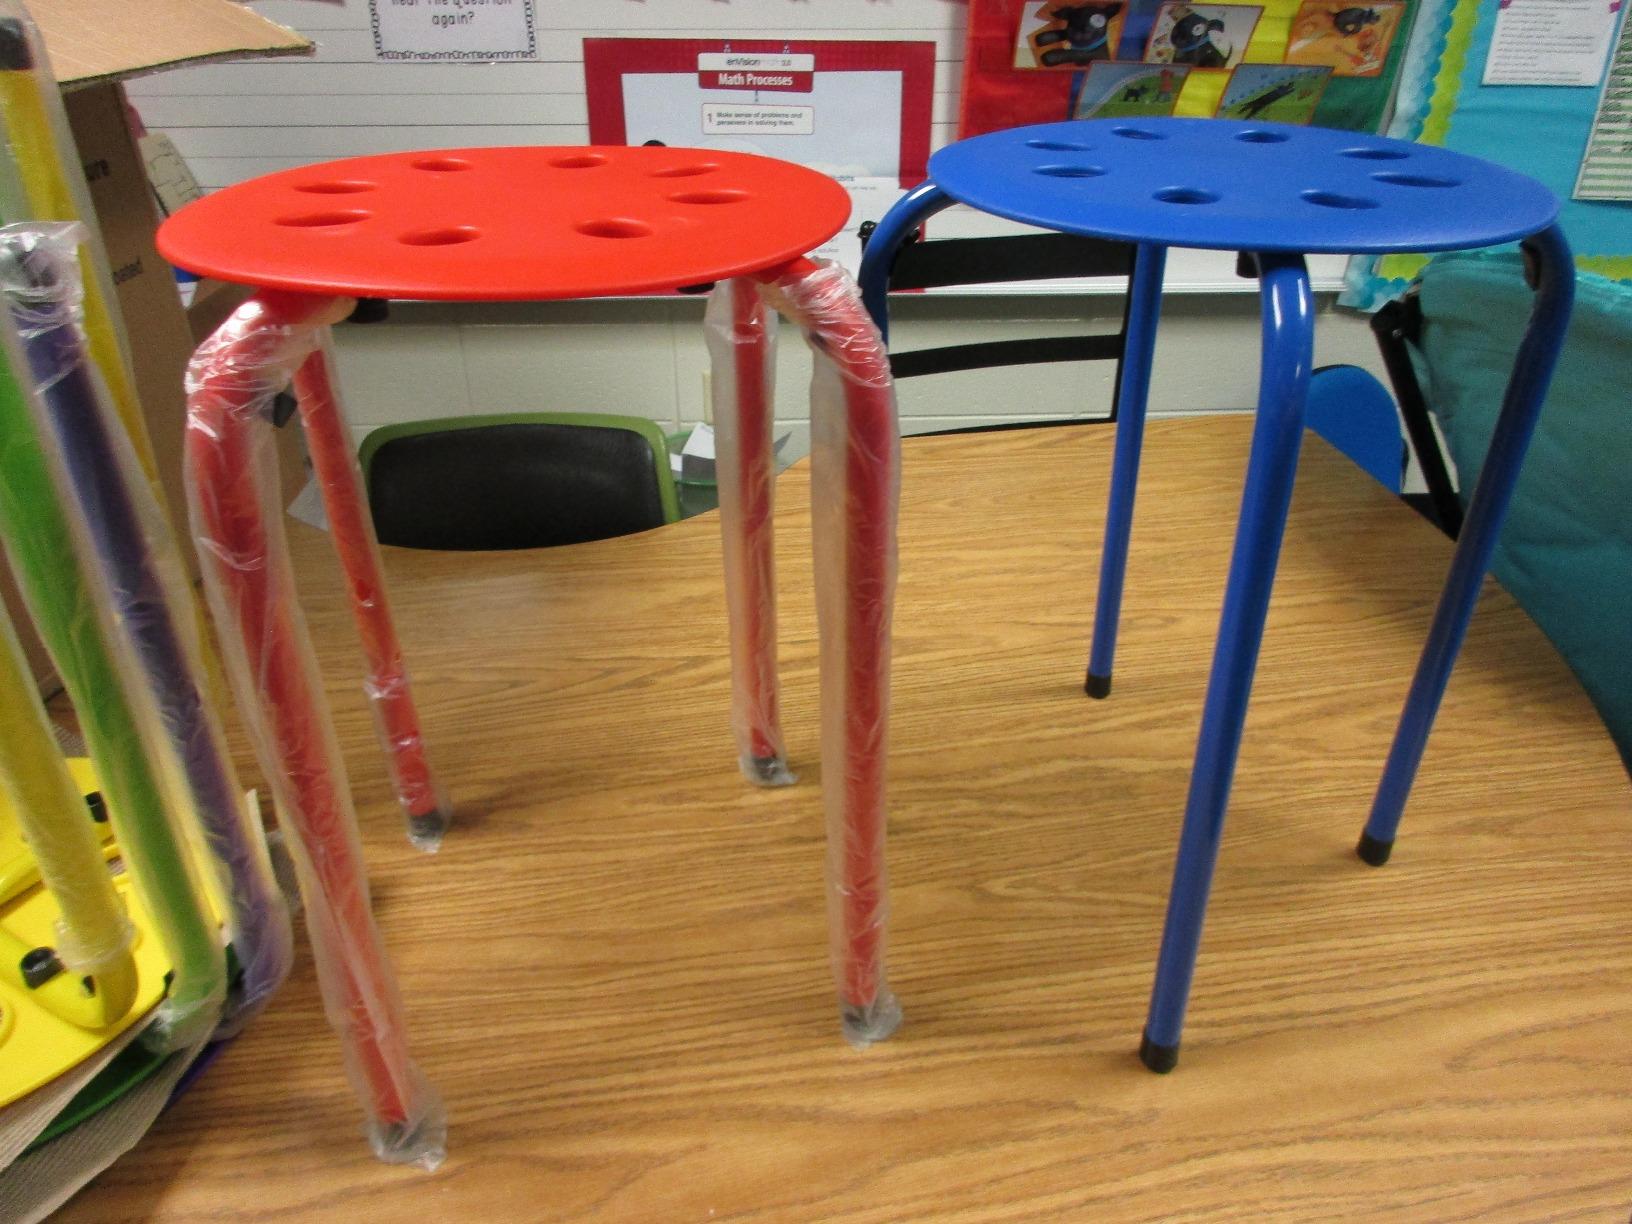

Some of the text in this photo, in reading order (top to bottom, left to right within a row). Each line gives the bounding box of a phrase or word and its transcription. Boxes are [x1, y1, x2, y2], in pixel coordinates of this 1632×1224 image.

[431, 11, 474, 28] again?
[718, 73, 793, 86] Math Processes
[707, 112, 713, 123] 1
